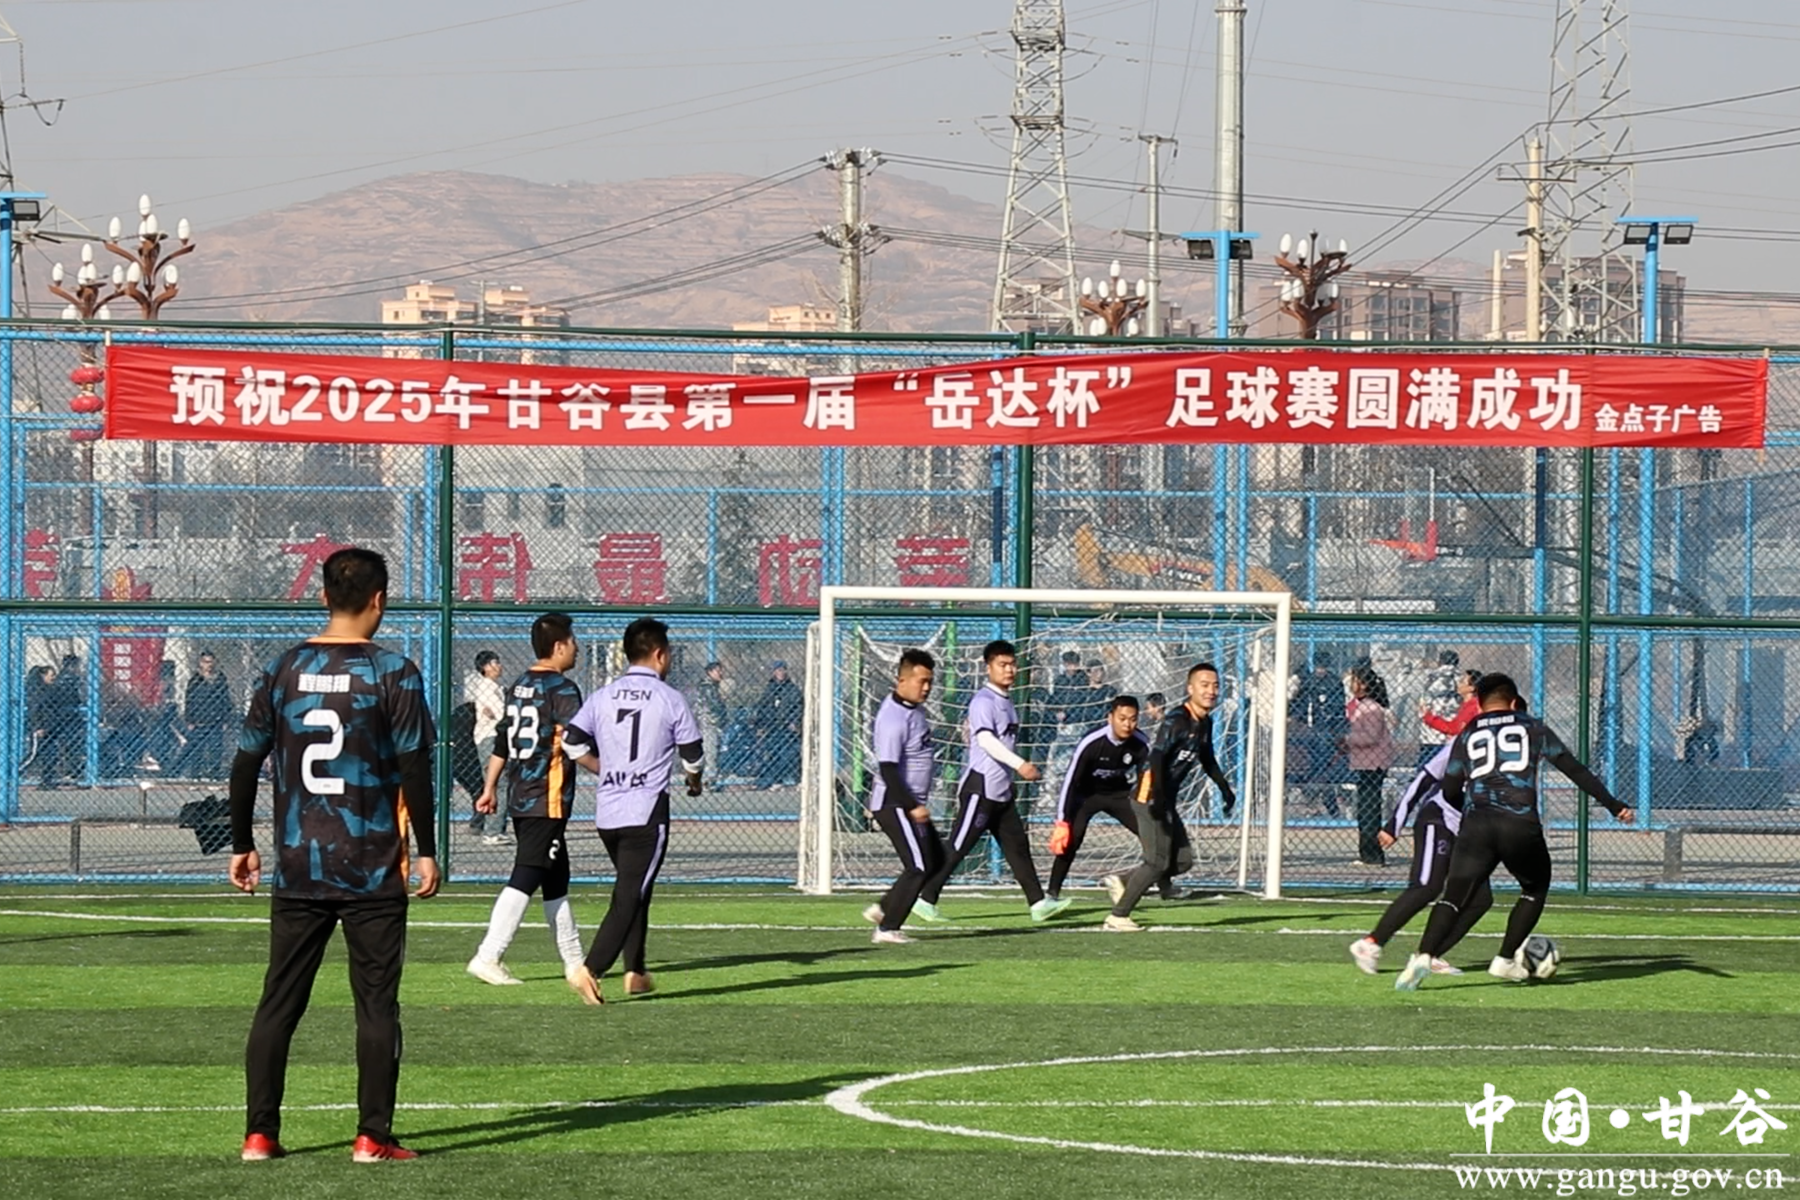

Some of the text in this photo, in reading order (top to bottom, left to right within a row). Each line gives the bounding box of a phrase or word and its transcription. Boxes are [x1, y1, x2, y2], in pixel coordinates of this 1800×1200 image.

[1594, 403, 1723, 433] 金点子广告
[612, 688, 652, 701] JTSN
[302, 709, 345, 795] 2
[507, 704, 540, 760] 23
[616, 708, 642, 763] 7
[1466, 724, 1529, 779] 99
